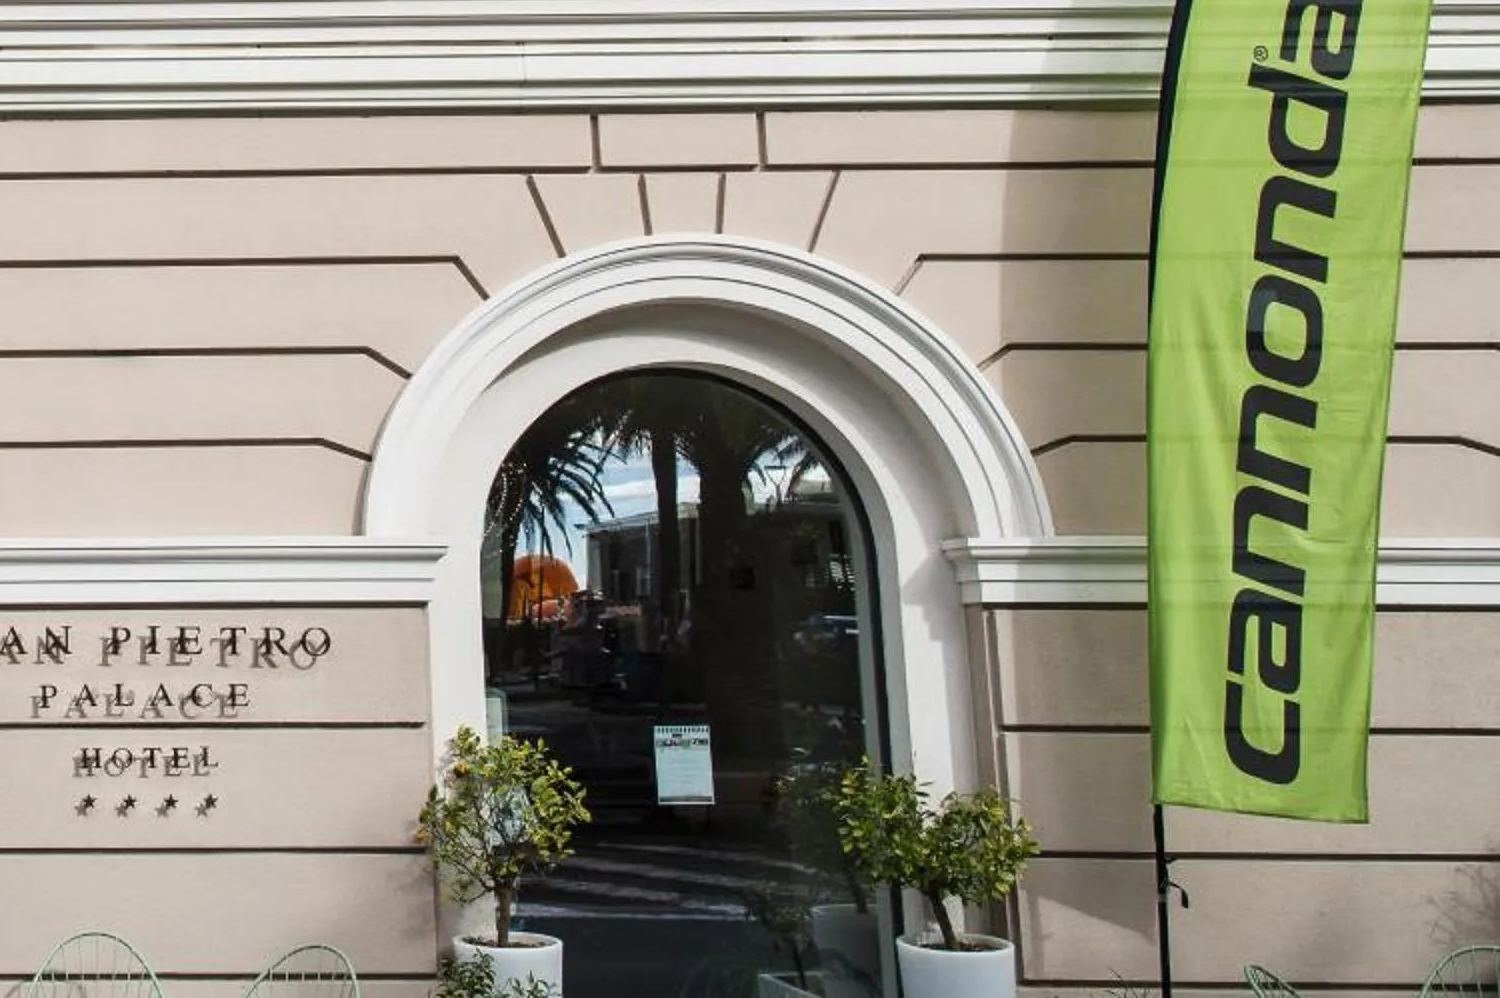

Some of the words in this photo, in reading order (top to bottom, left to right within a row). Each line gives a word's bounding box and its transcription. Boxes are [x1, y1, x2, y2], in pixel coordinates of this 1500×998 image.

[109, 626, 331, 657] PIETRO
[40, 683, 250, 709] PALACE
[80, 746, 218, 769] HOTEL
